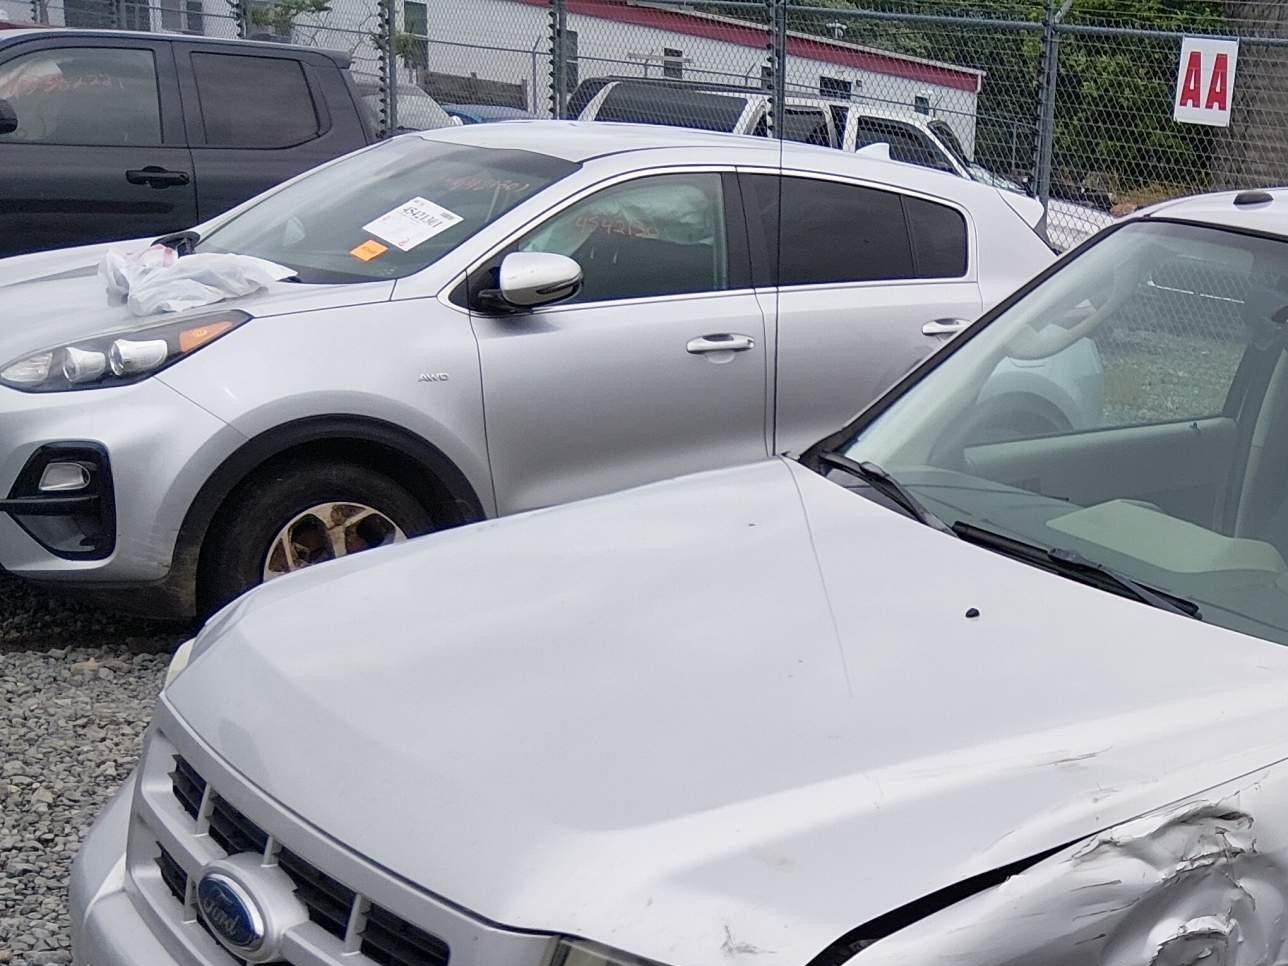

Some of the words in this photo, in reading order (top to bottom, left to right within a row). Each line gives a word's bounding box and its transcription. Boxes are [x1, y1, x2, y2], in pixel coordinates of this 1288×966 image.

[1180, 51, 1228, 111] AA
[417, 372, 449, 383] AWD
[203, 886, 242, 937] Ford
